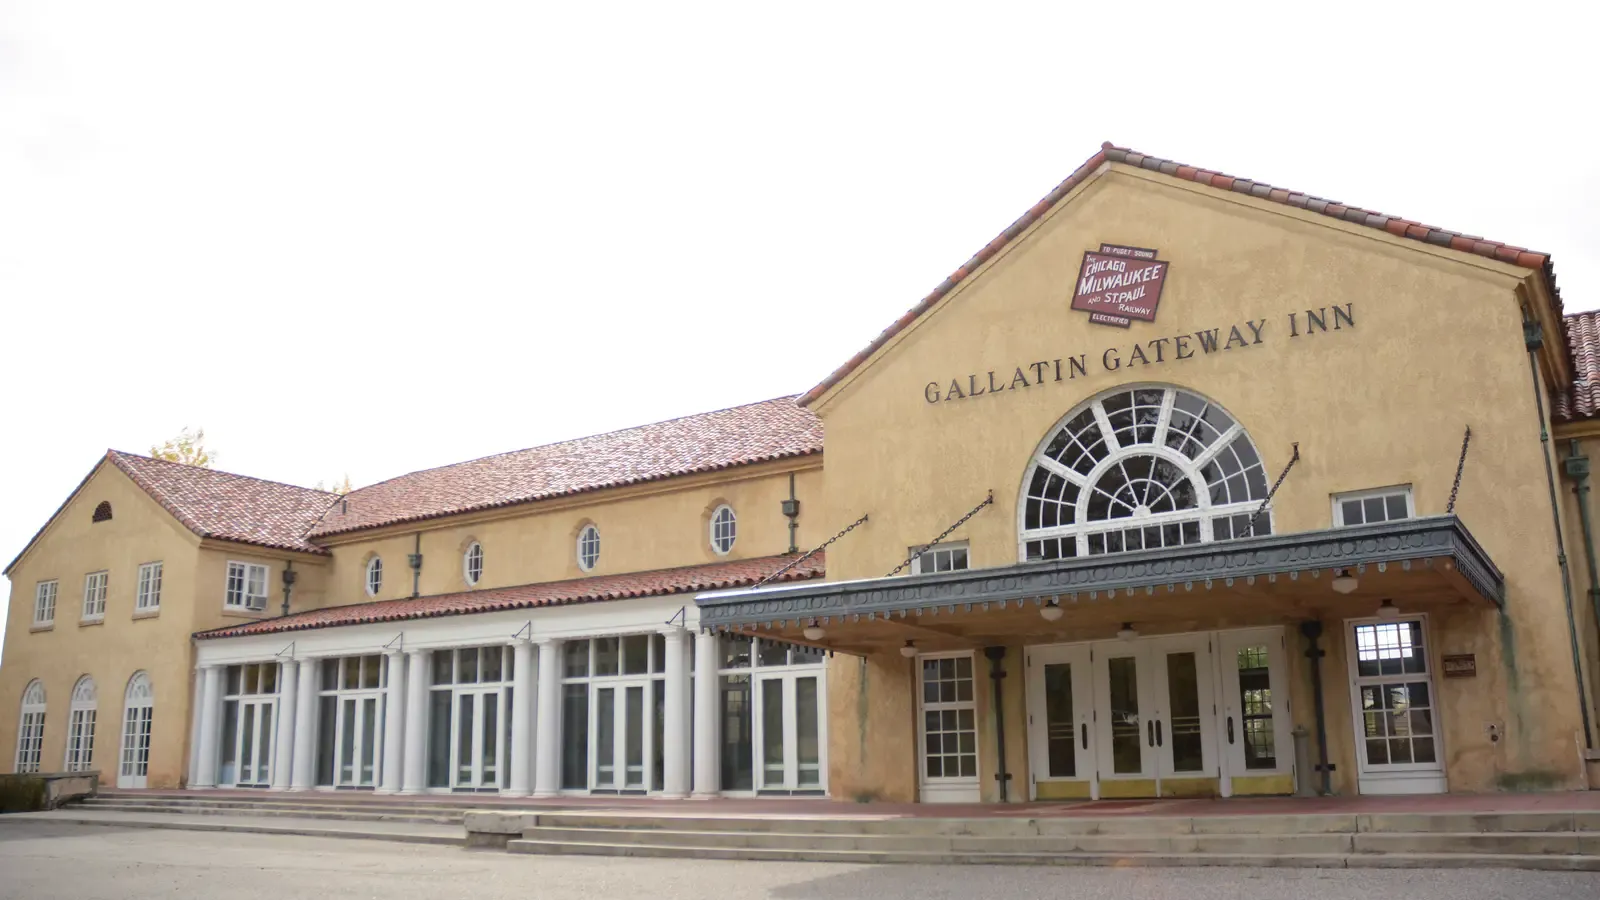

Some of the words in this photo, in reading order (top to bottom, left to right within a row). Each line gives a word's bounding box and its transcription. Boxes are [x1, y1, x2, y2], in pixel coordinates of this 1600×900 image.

[1113, 247, 1131, 255] PUGET
[1134, 250, 1153, 258] SOUND
[1085, 260, 1127, 277] CHICAGO
[1078, 265, 1162, 295] MILWAUKEE
[1088, 296, 1101, 304] AND
[1119, 304, 1151, 315] RAILWAY
[1092, 313, 1129, 324] ELECTRIFIED
[923, 354, 1087, 404] GALLATIN
[1102, 318, 1267, 371] GATEWAY
[1289, 302, 1356, 338] INN
